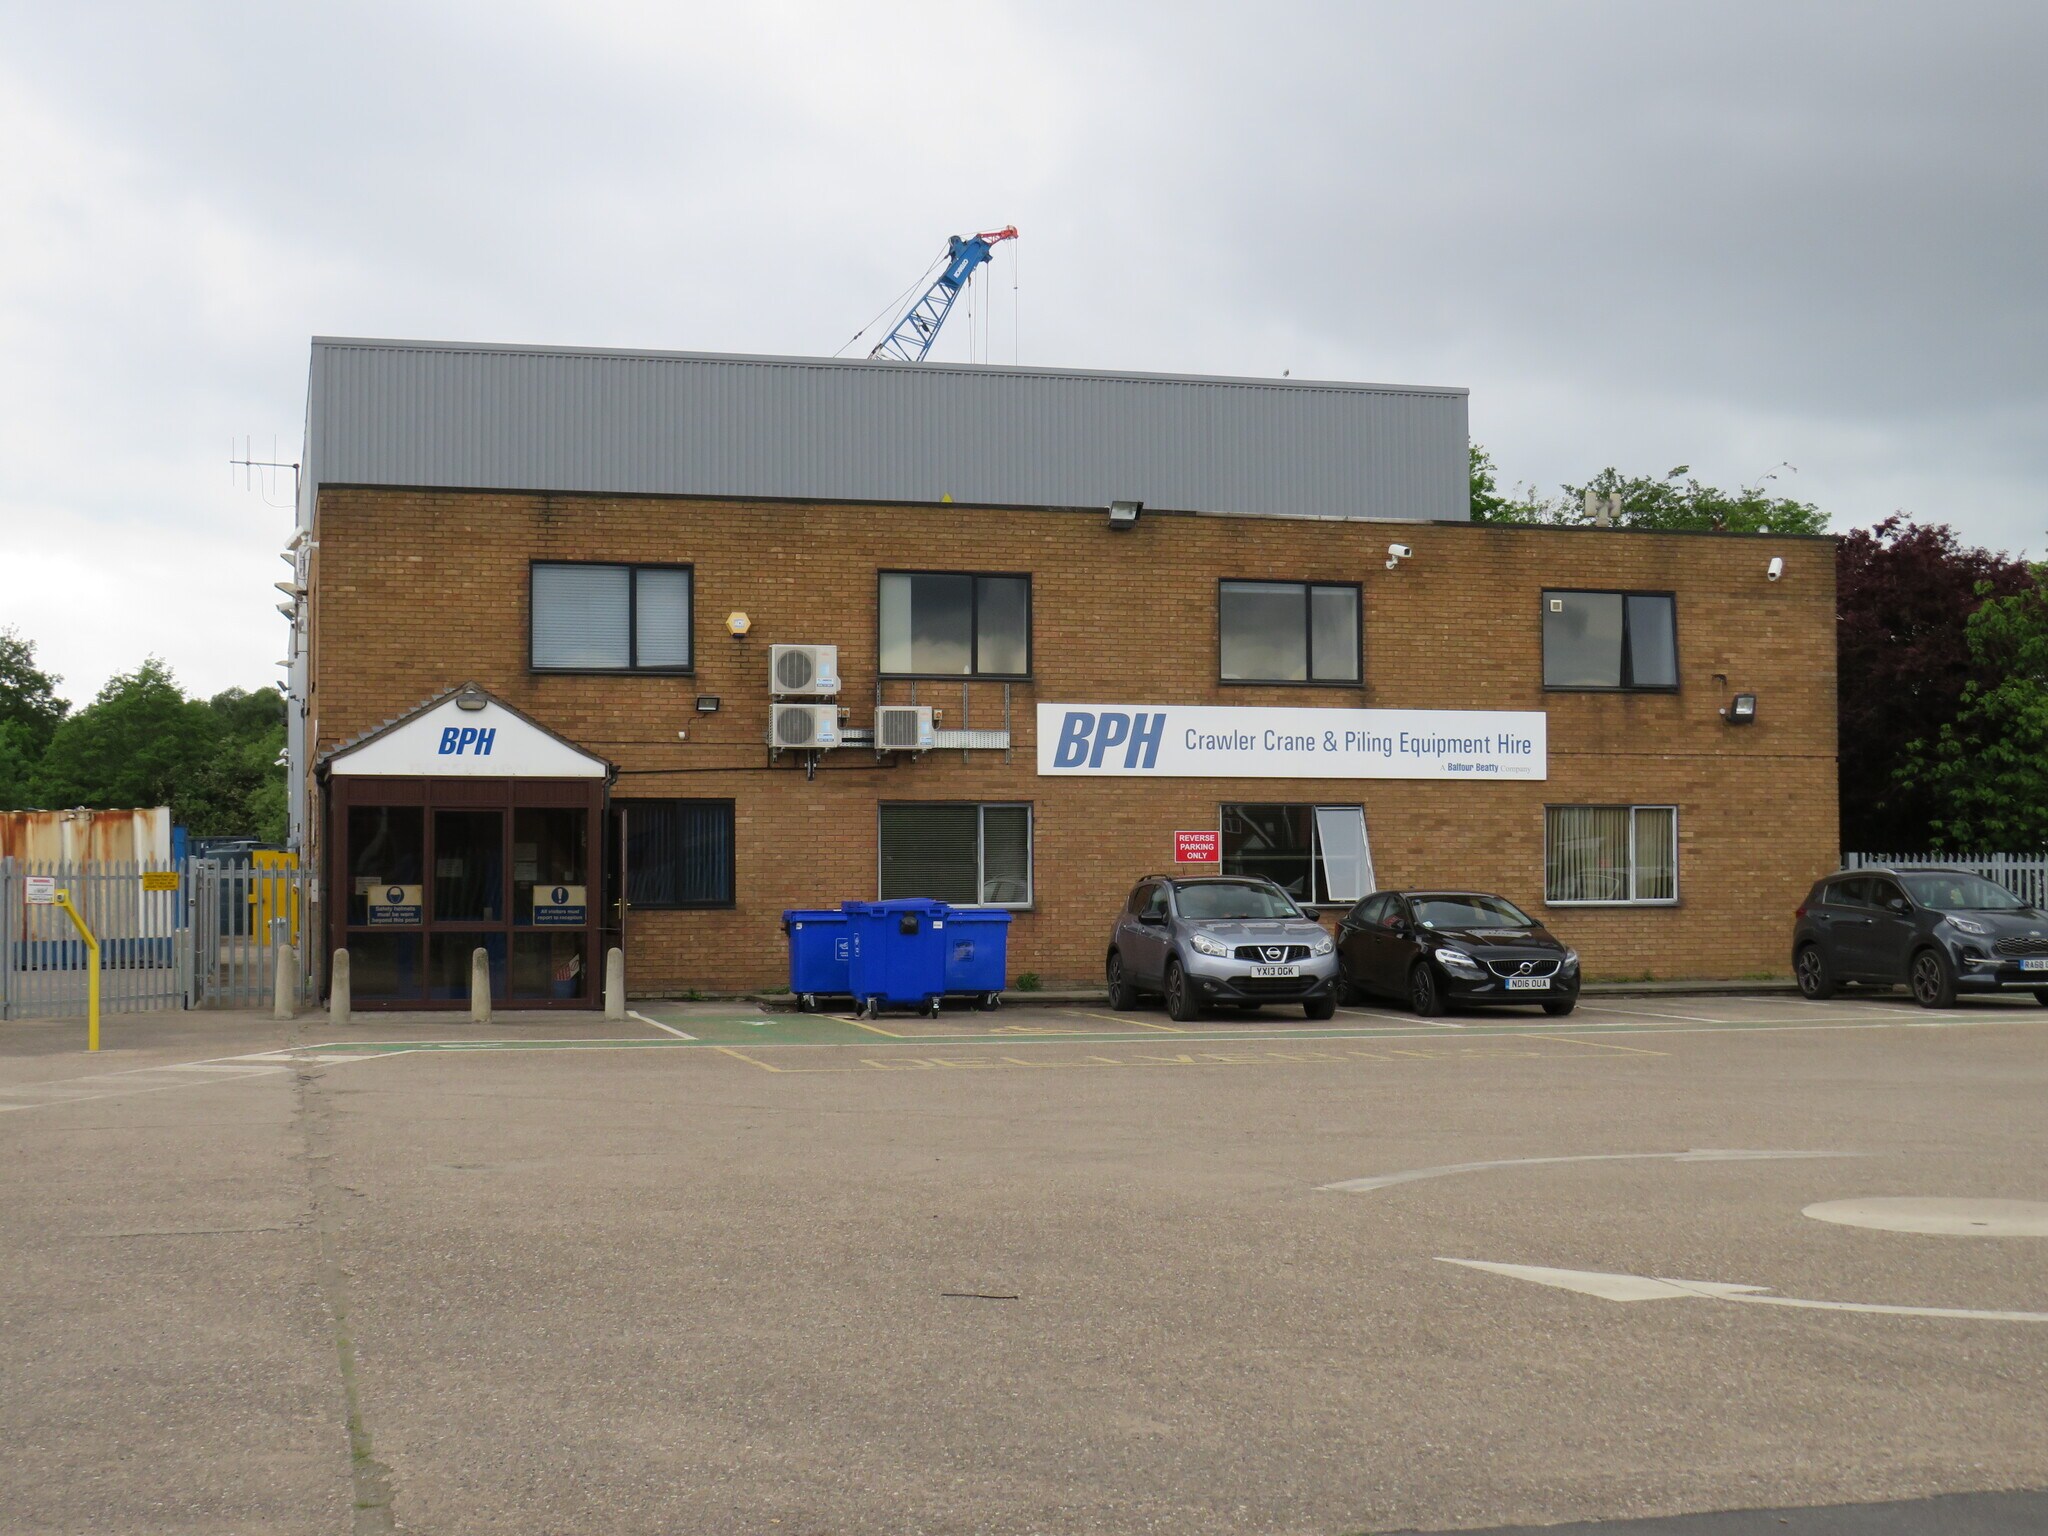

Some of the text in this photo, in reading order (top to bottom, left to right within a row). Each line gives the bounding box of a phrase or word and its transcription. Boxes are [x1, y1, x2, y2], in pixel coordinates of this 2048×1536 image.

[438, 727, 497, 755] BPH
[1053, 712, 1532, 769] BPH Crawler Crane & Piling Equipment Hire
[1447, 763, 1474, 772] Balfour
[1475, 763, 1499, 773] Beatty
[1500, 765, 1531, 774] Company
[1179, 834, 1215, 842] REVERSE
[1180, 843, 1214, 851] PARKING
[1186, 852, 1208, 860] ONLY
[1257, 967, 1276, 976] YX13
[1512, 979, 1530, 988] ND16
